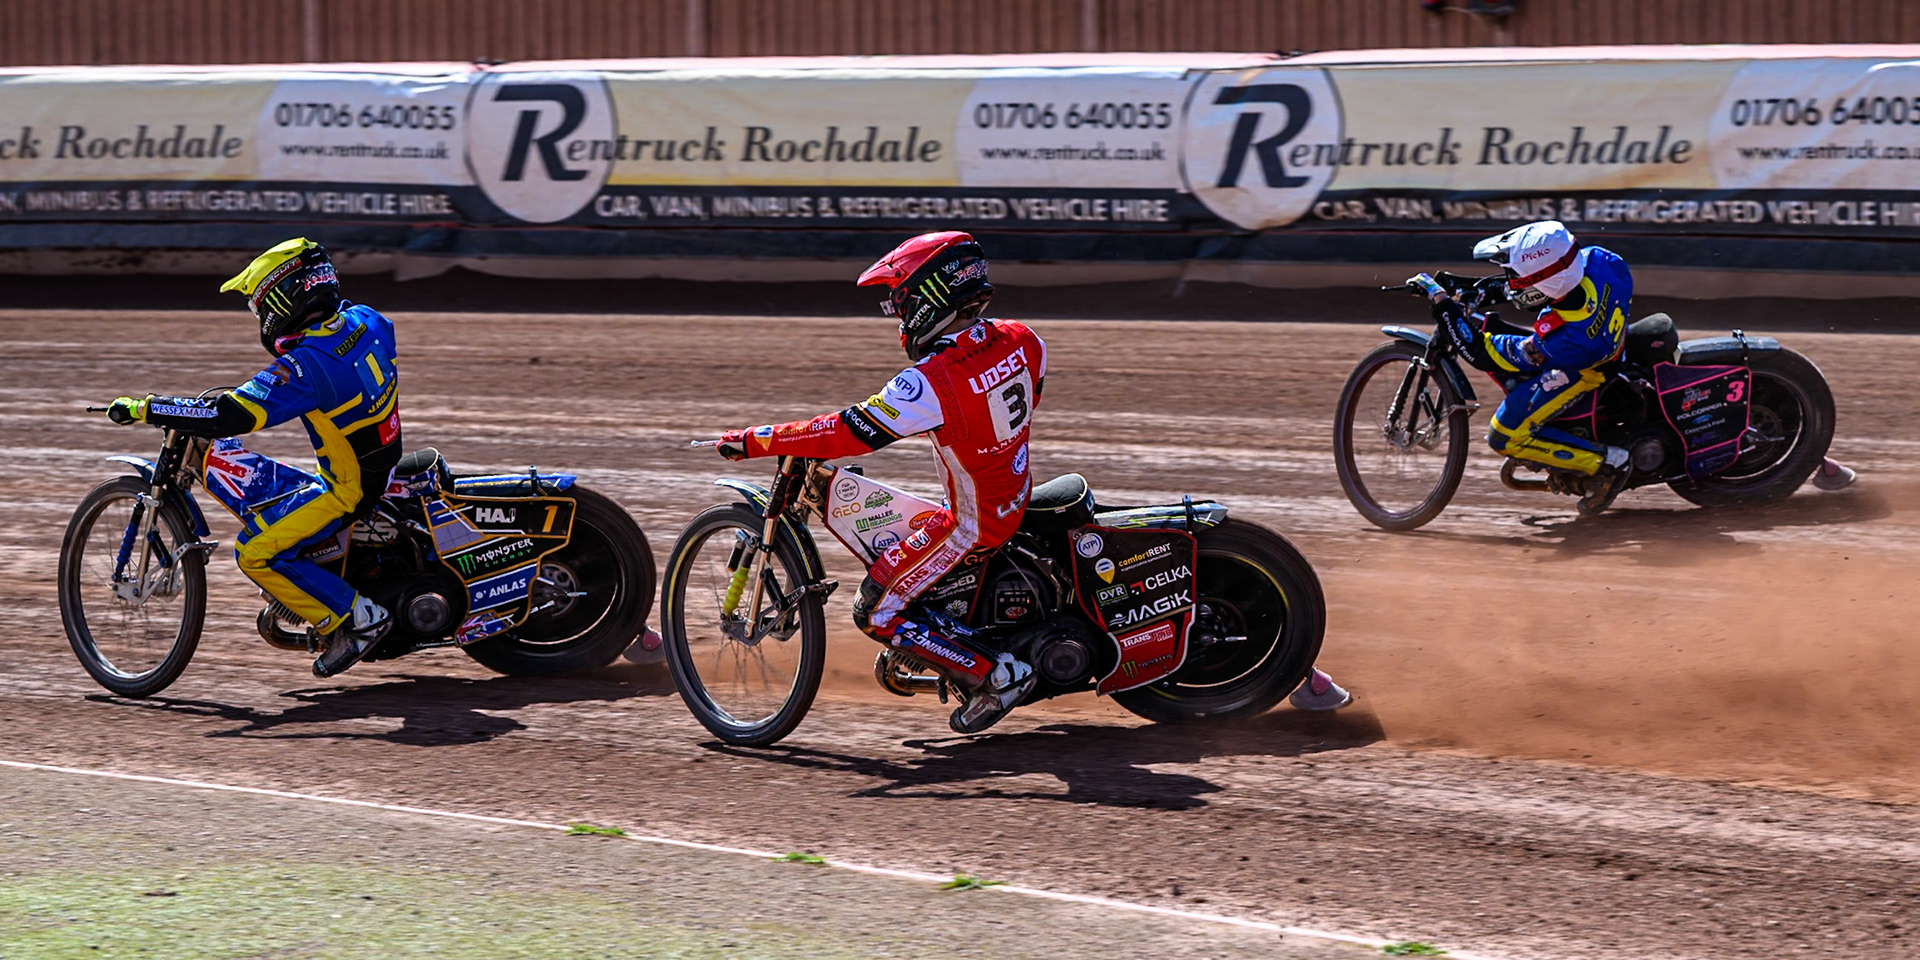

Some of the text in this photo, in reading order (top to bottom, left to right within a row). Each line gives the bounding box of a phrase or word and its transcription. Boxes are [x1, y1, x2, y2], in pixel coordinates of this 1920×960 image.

[274, 102, 456, 131] 01706 640055
[973, 103, 1172, 130] 01706 640055
[1731, 99, 1822, 127] 01706
[54, 125, 244, 160] Rochdale
[739, 126, 942, 163] Rochdale
[980, 144, 1166, 161] www.rentruck.co.uk
[1475, 125, 1693, 166] Rochdale
[126, 190, 144, 211] &
[147, 190, 303, 213] REFRIGERATED
[306, 192, 397, 215] VEHICLE
[402, 194, 453, 215] HIRE
[712, 196, 810, 218] MINIBUS
[817, 196, 837, 218] &
[839, 196, 1008, 220] REFRIGERATED
[1009, 198, 1107, 221] VEHICLE
[1112, 199, 1169, 222] HIRE
[1559, 199, 1582, 221] &
[1767, 201, 1876, 225] VEHICLE
[1607, 306, 1626, 343] 3
[968, 346, 1029, 394] LIDSEY
[894, 376, 916, 395] ATPI
[1726, 381, 1745, 402] 3
[1002, 382, 1027, 430] 3
[542, 505, 558, 533] 1
[868, 510, 894, 521] MALLEE
[476, 537, 533, 563] MONSTER
[1082, 538, 1099, 551] ATPI
[1118, 542, 1171, 567] comfortRENT
[489, 578, 527, 598] ANLAS
[1145, 565, 1192, 590] CELKA
[1099, 586, 1125, 601] DVR
